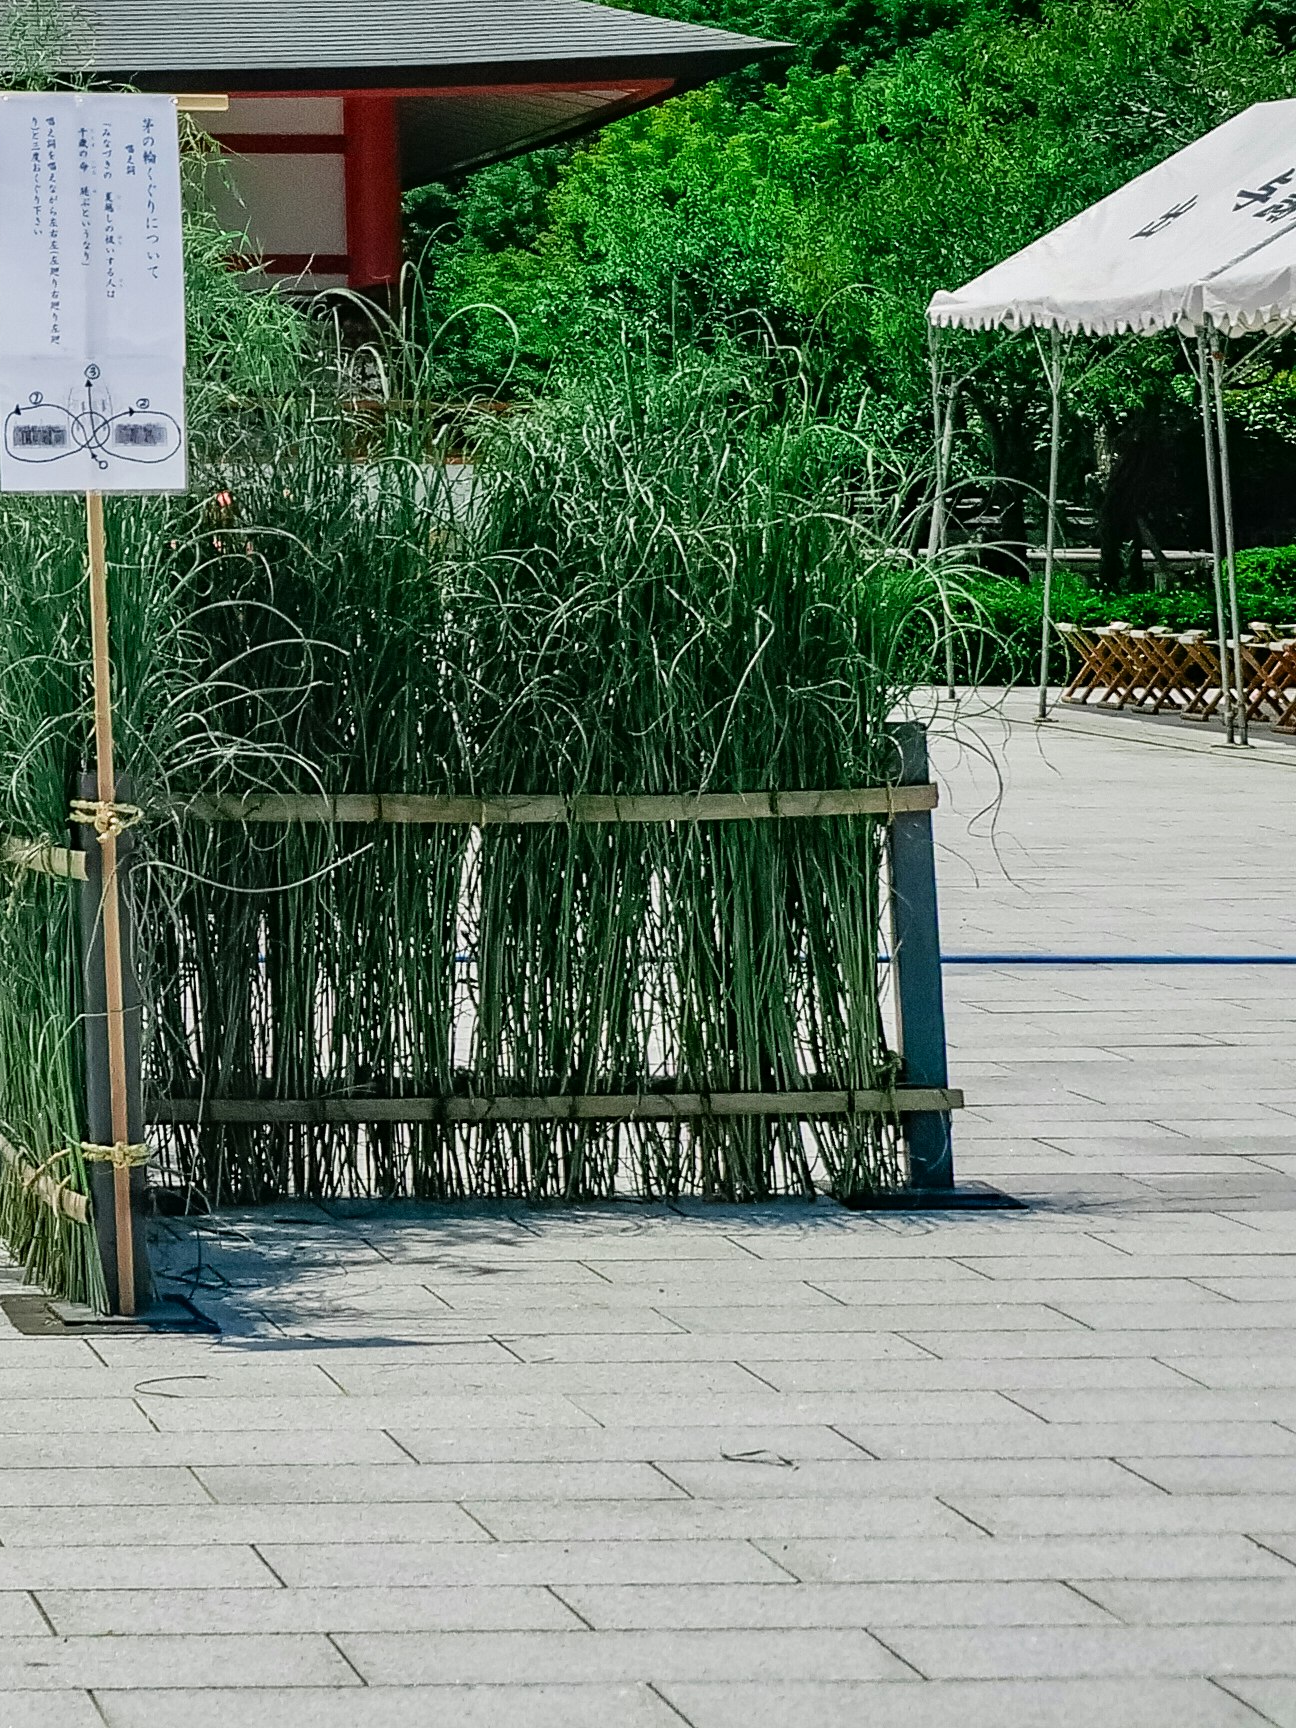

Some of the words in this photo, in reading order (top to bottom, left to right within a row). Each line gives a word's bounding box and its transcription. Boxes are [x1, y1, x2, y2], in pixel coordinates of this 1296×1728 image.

[124, 144, 136, 176] 唱え詞
[142, 117, 161, 279] 茅の輪くぐりについて
